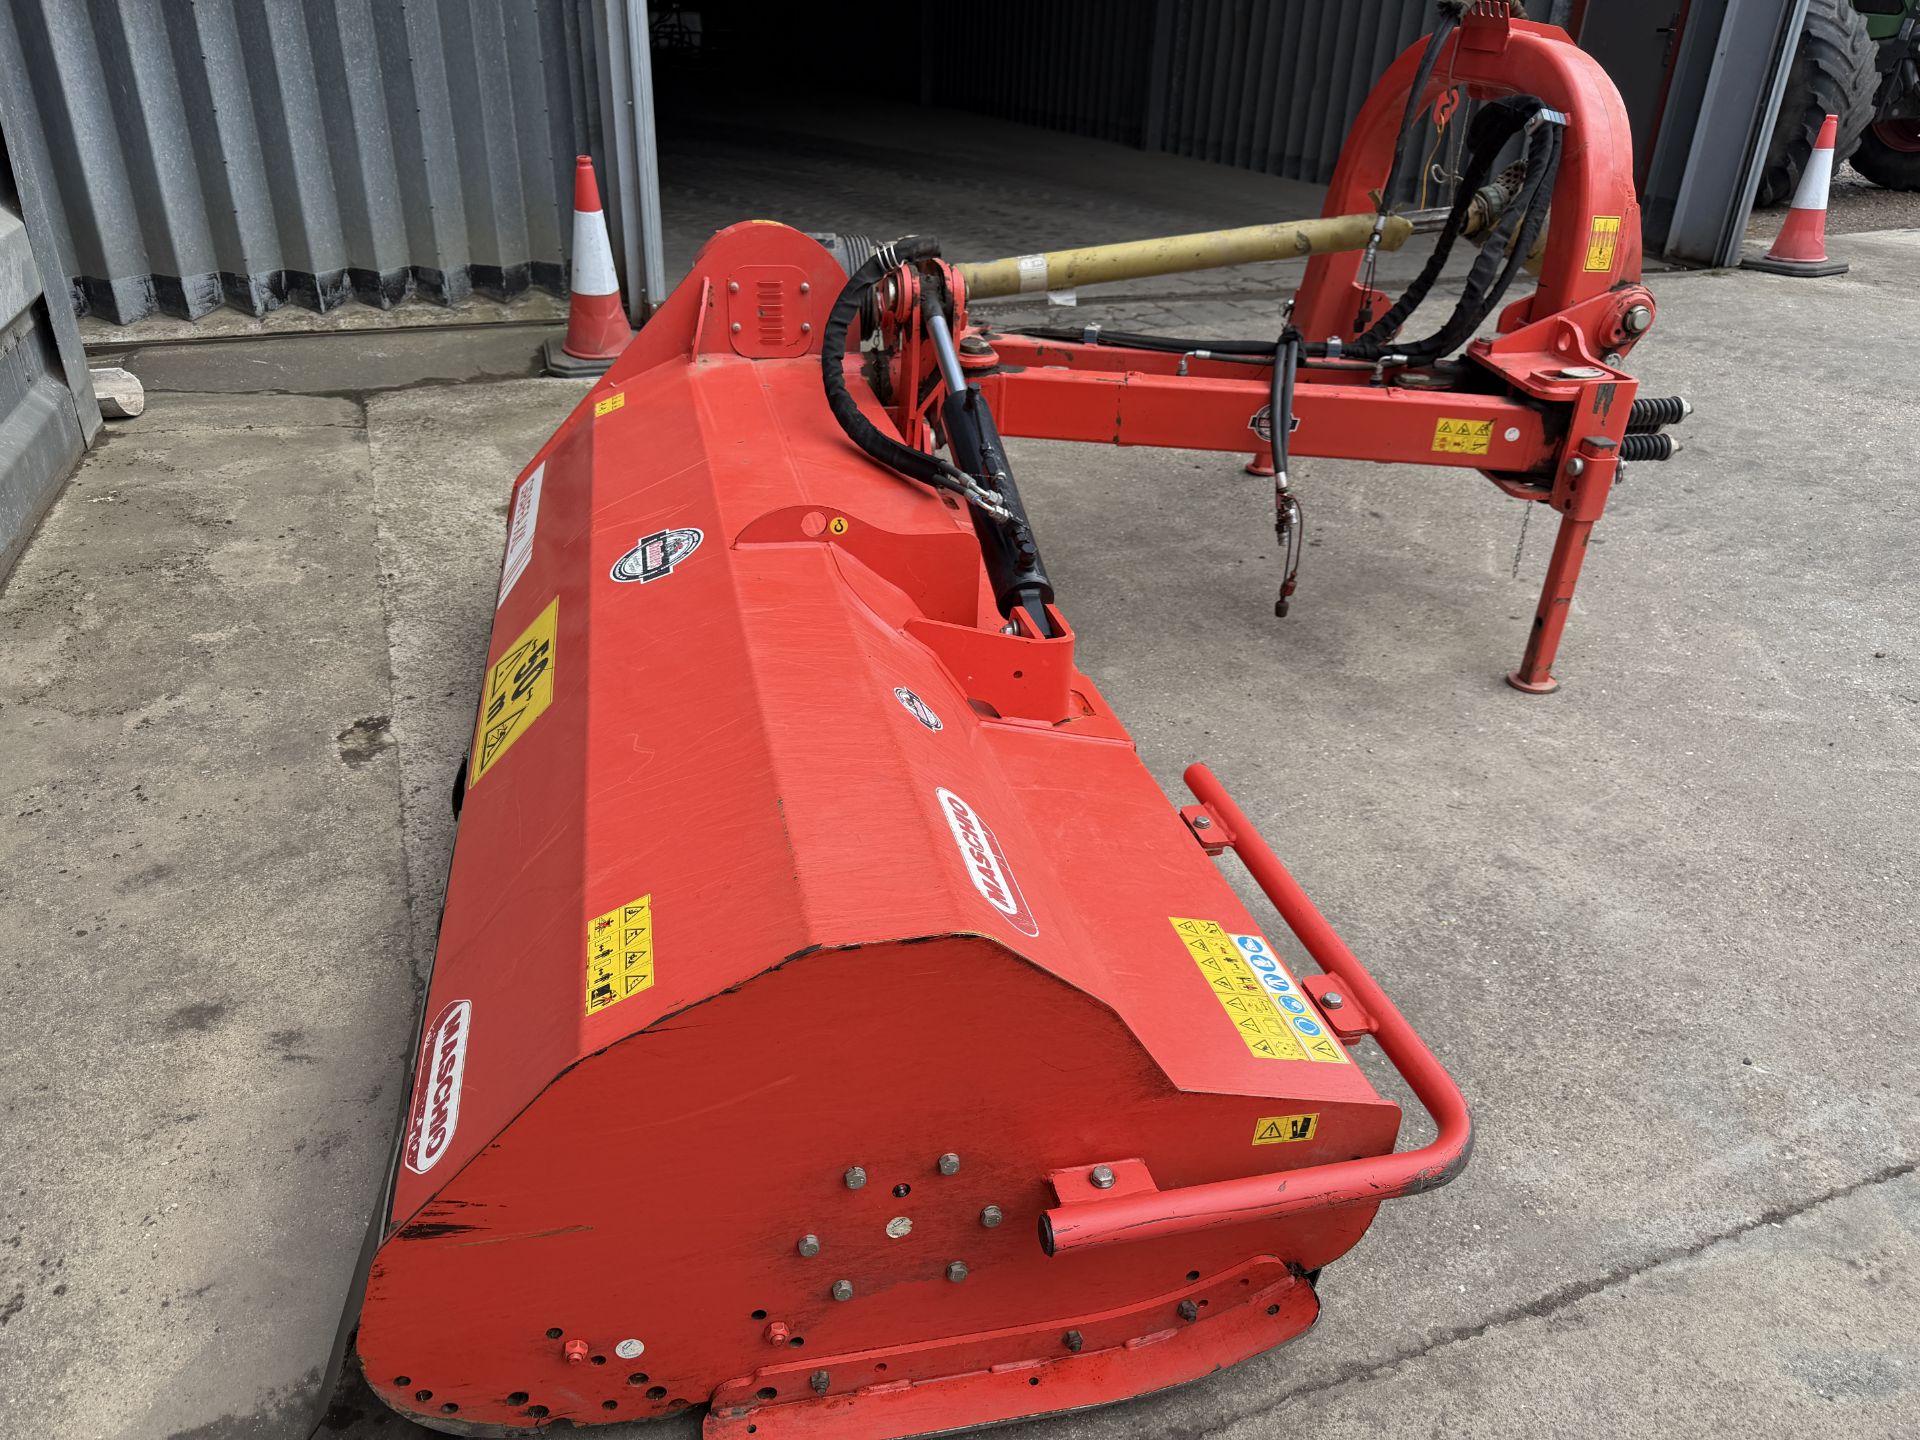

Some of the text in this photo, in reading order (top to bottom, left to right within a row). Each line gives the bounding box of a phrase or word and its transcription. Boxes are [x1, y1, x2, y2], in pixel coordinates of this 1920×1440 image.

[486, 691, 507, 725] m
[511, 638, 550, 702] 50
[947, 796, 1010, 909] MASCHIO
[425, 1007, 463, 1159] MASCHIO
